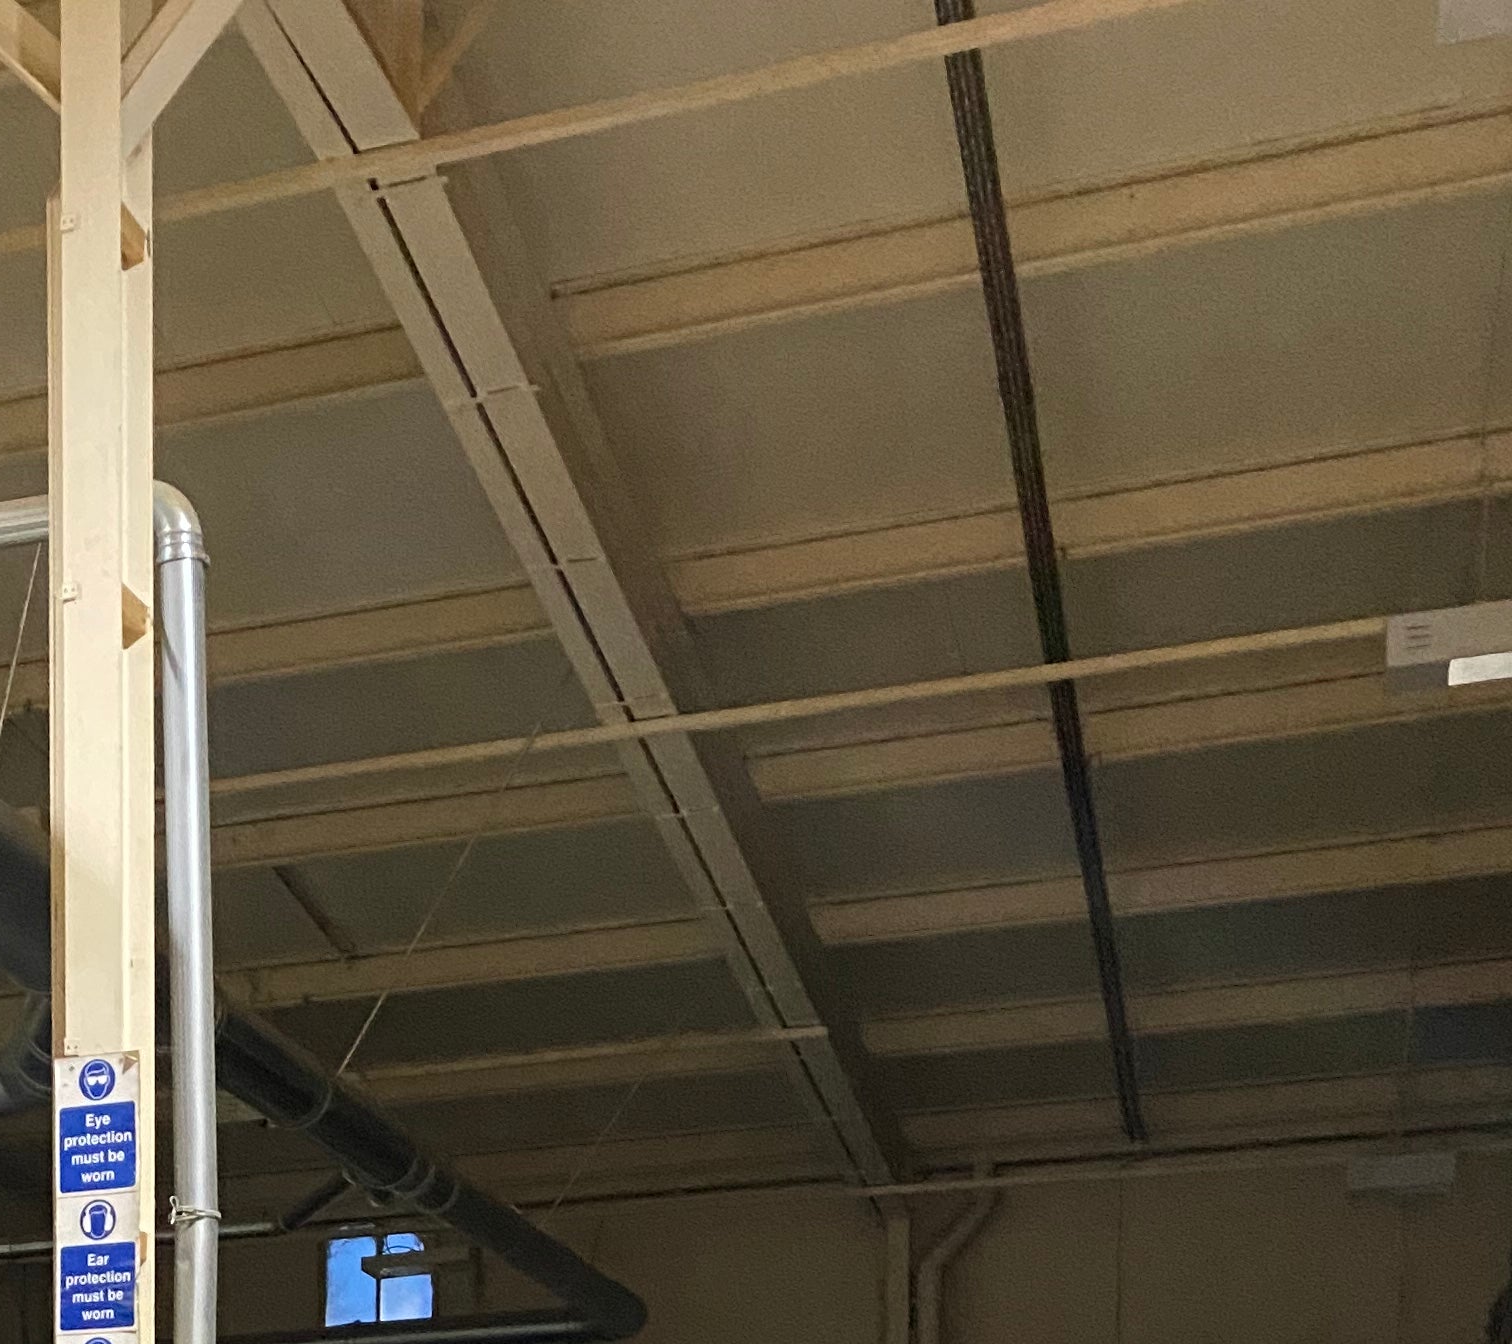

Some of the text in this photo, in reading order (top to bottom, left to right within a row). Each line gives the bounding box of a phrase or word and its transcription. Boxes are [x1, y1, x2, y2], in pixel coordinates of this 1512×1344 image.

[85, 1113, 111, 1130] Eye
[63, 1130, 133, 1151] protection
[71, 1149, 125, 1166] must be
[80, 1170, 115, 1184] worn
[87, 1253, 110, 1267] Ear
[65, 1270, 131, 1290] protection
[72, 1288, 124, 1304] must be
[81, 1308, 115, 1321] worn
